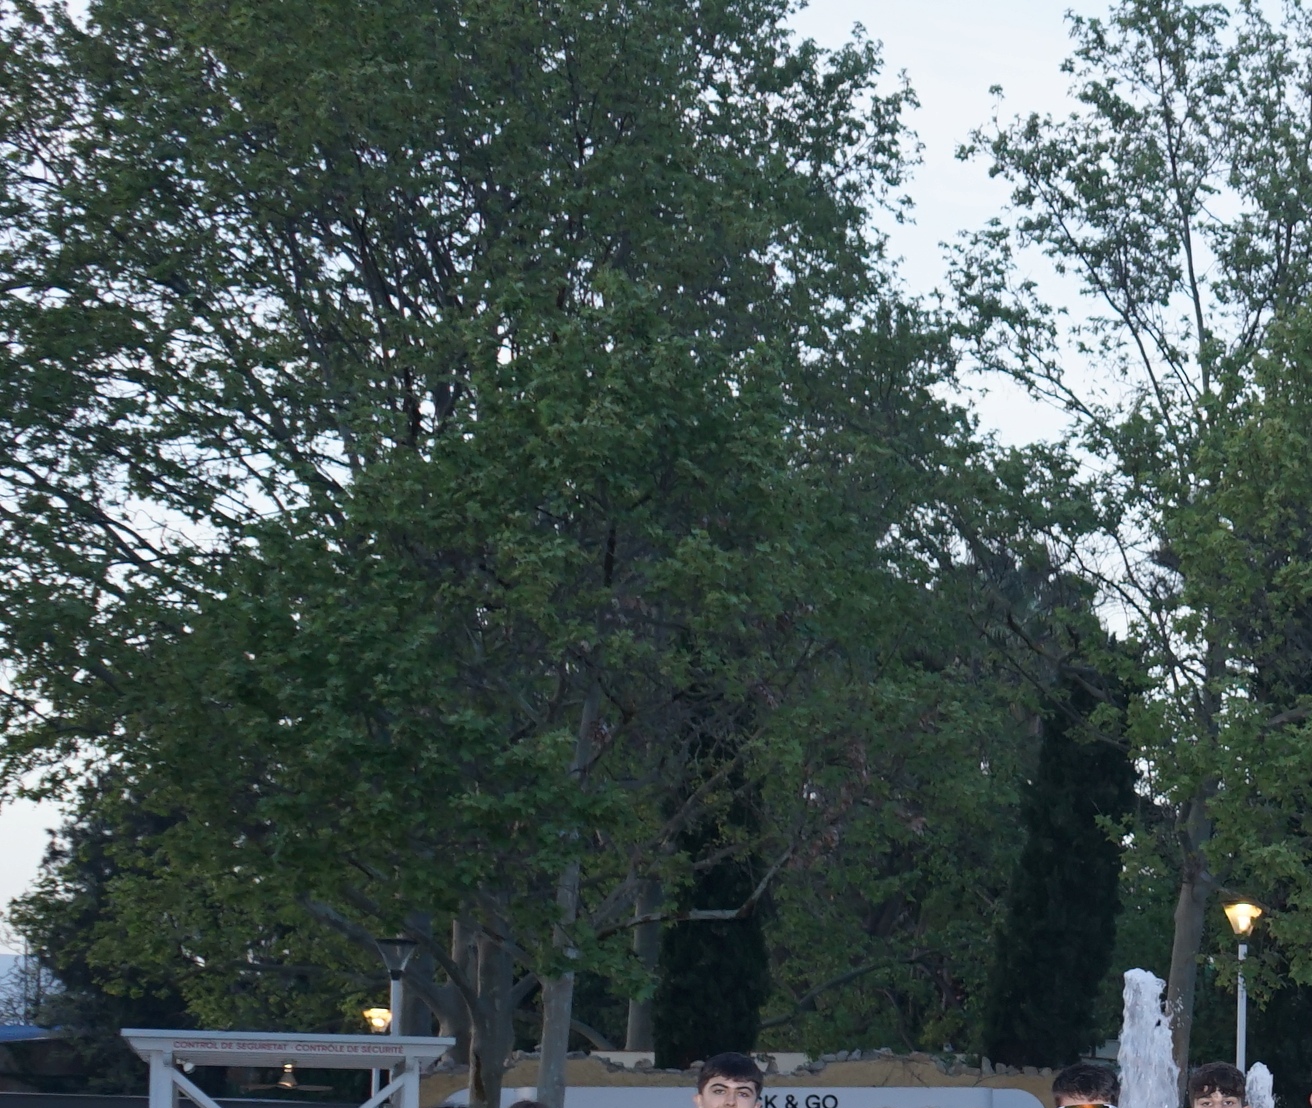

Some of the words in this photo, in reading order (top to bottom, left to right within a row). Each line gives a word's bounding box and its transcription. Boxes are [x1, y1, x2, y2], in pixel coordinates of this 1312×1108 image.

[173, 1041, 218, 1049] CONTROL
[221, 1042, 233, 1050] DE
[236, 1042, 289, 1051] SEGURETAT
[295, 1043, 344, 1053] CONTRÔLE
[347, 1045, 359, 1053] DE
[361, 1044, 404, 1054] SÉCURITÉ
